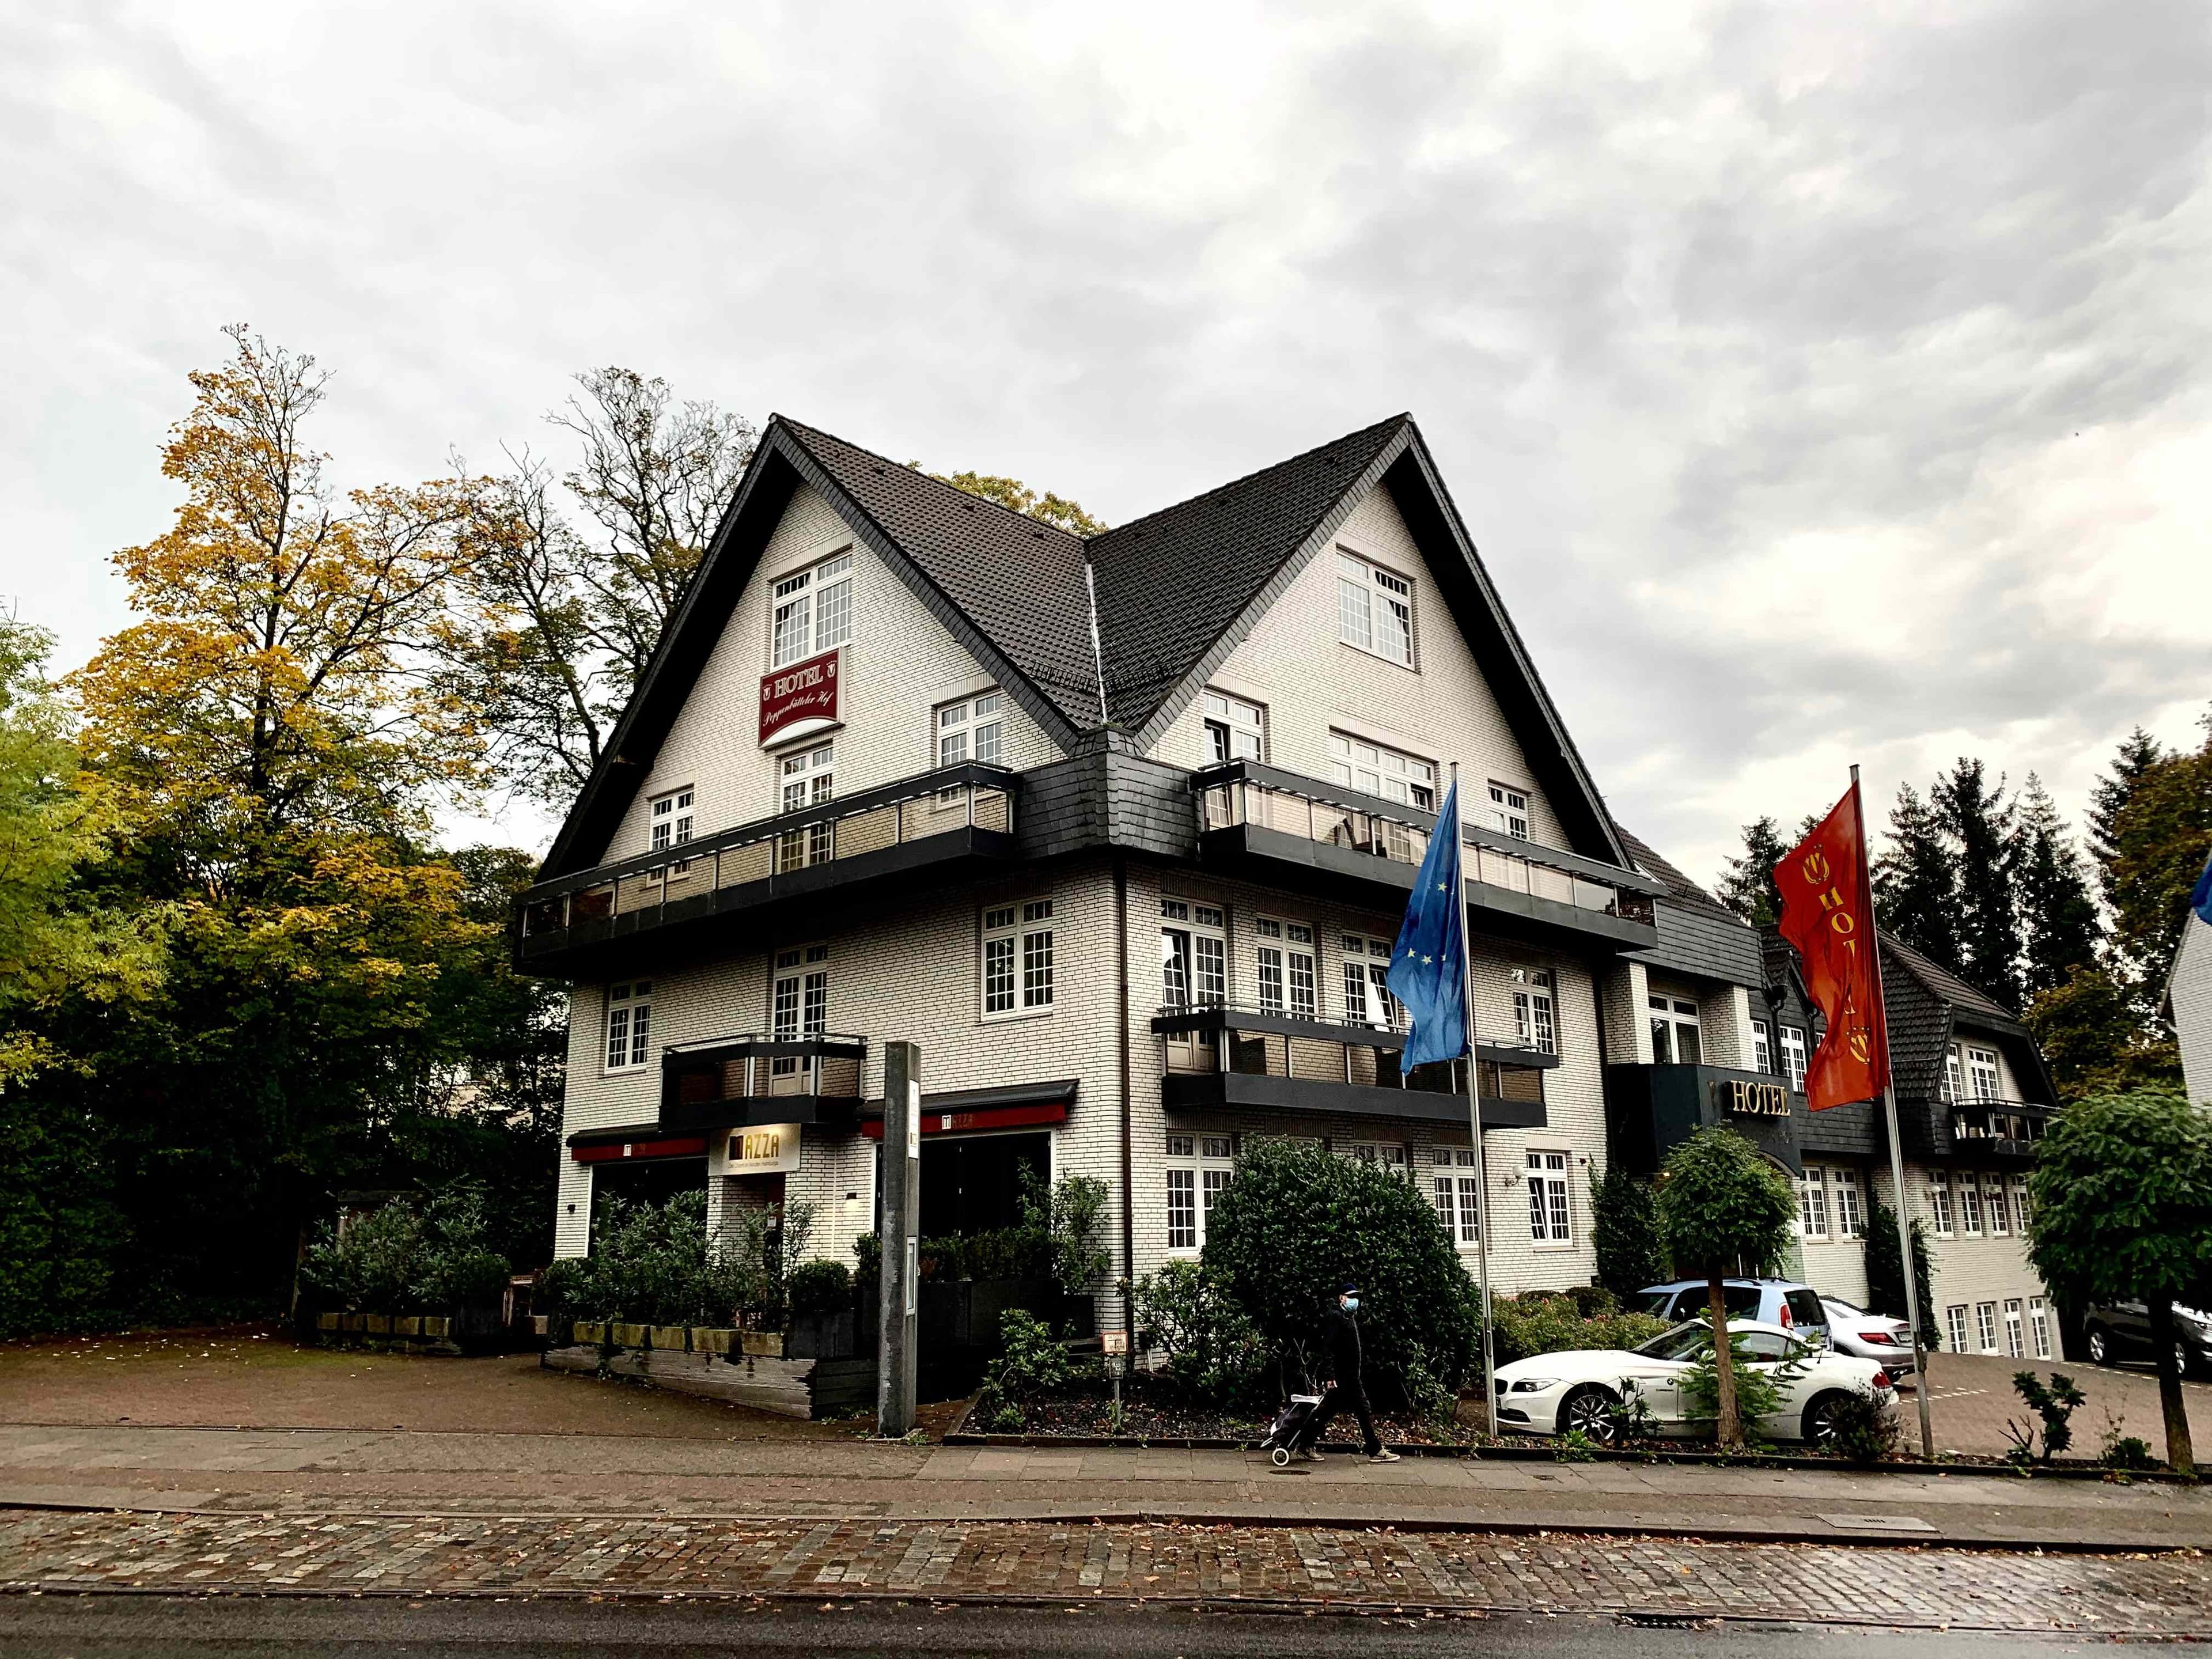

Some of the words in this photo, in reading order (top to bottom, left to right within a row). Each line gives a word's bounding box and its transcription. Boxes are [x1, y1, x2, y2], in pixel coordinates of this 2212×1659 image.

[774, 664, 824, 699] HOTEL
[816, 691, 834, 707] Hof
[1730, 1080, 1791, 1116] HOTEL
